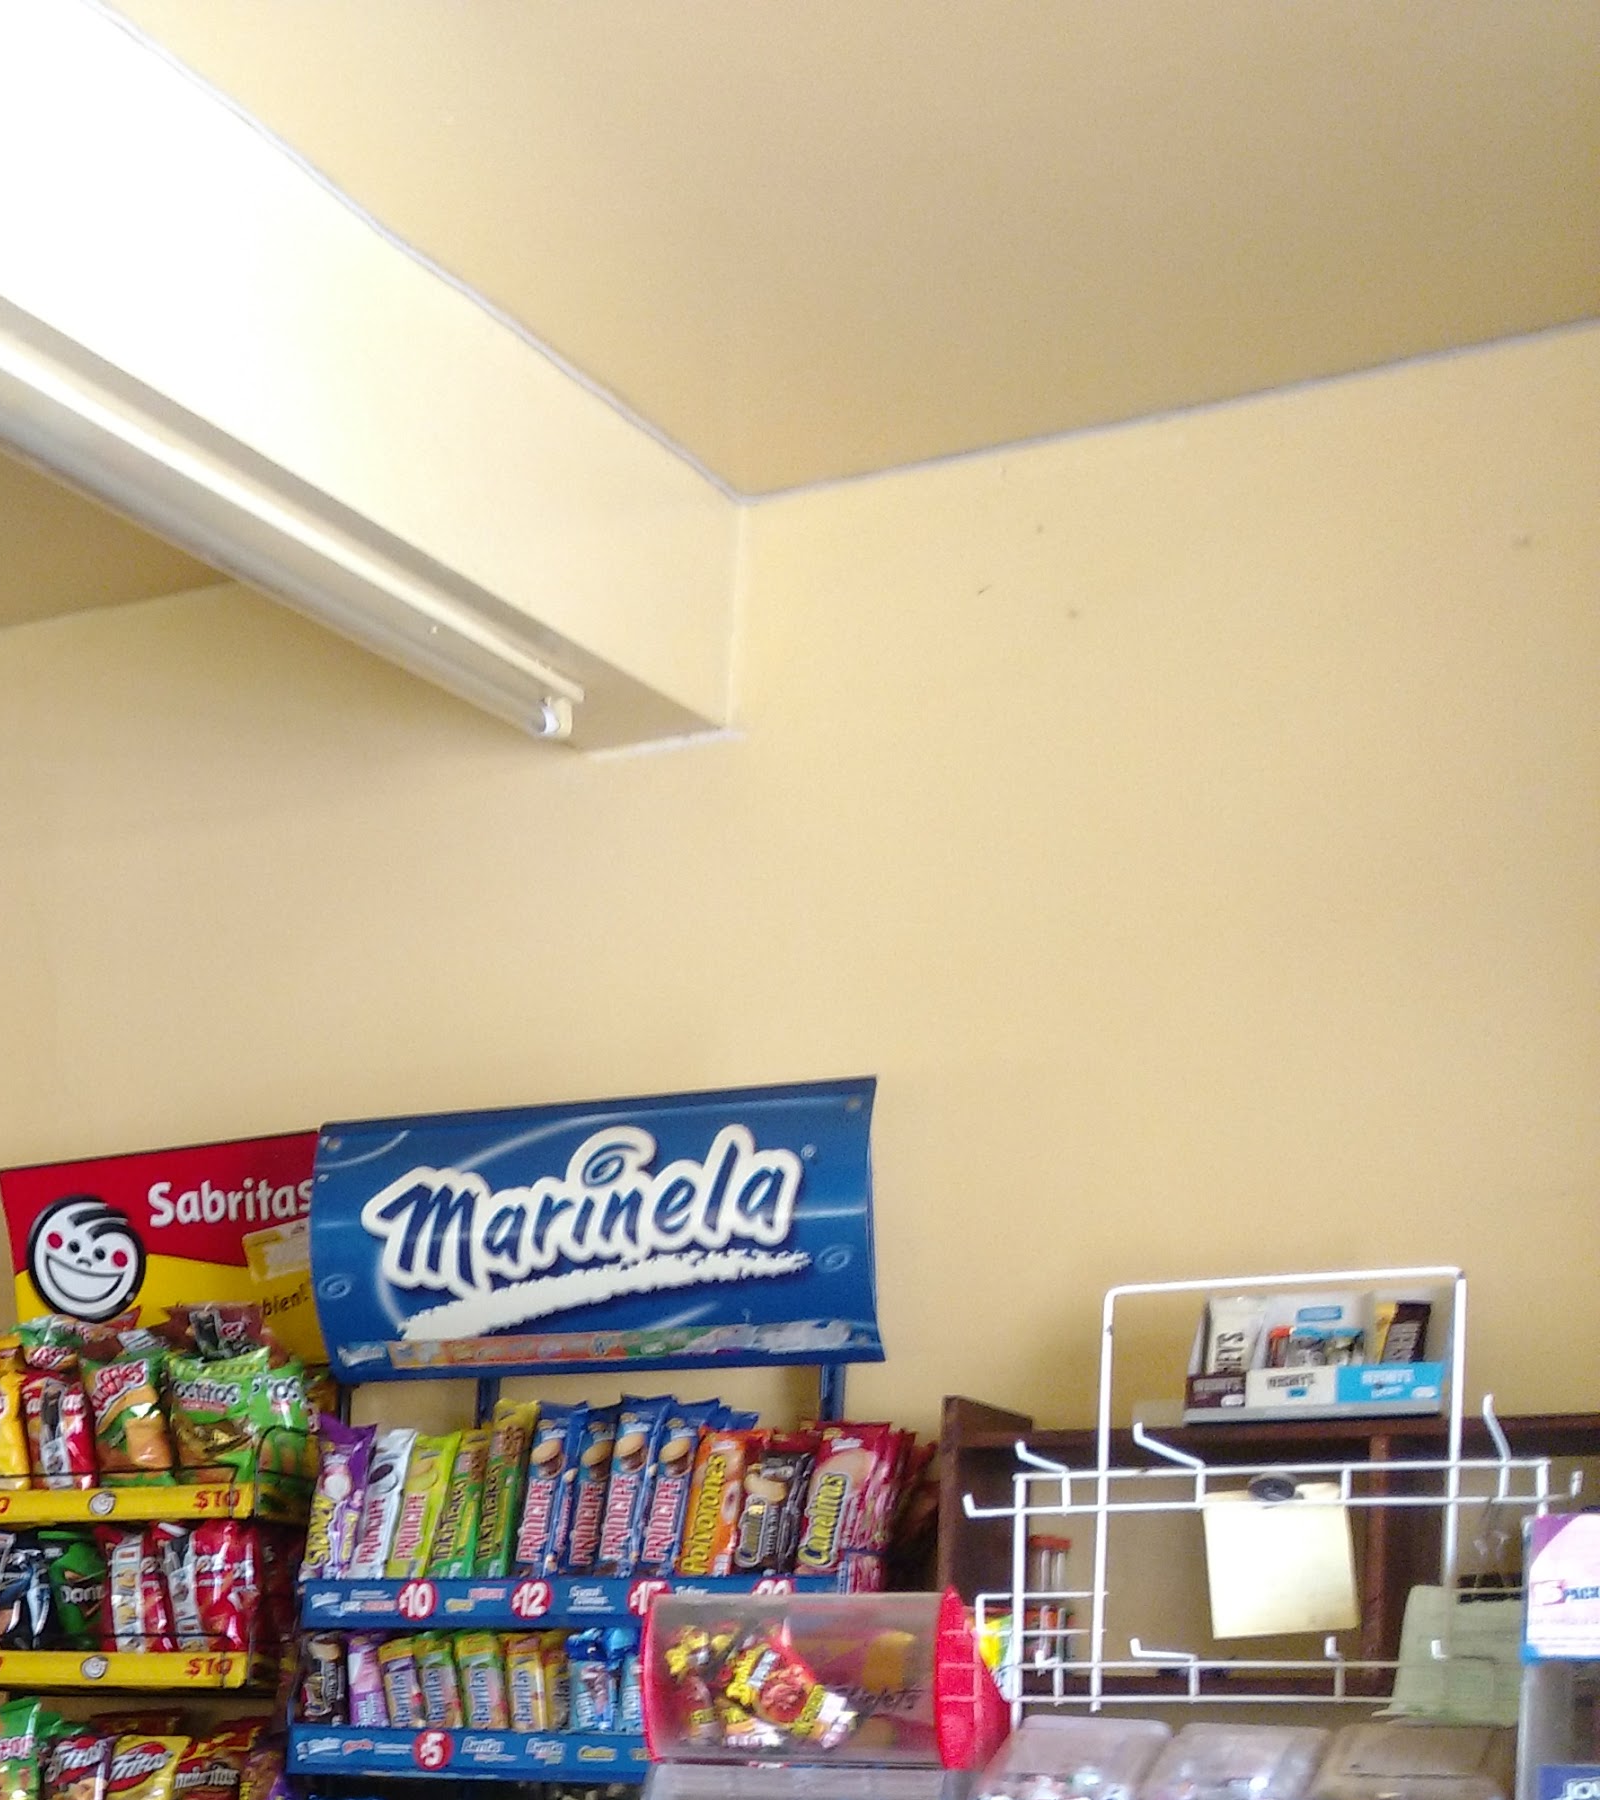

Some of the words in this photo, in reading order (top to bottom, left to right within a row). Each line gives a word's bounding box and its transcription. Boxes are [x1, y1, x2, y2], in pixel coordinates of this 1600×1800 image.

[148, 1177, 314, 1228] Sabritas
[364, 1124, 802, 1296] Marinela
[195, 1489, 241, 1509] $10
[184, 1658, 232, 1677] $10
[109, 1751, 174, 1783] Fritos
